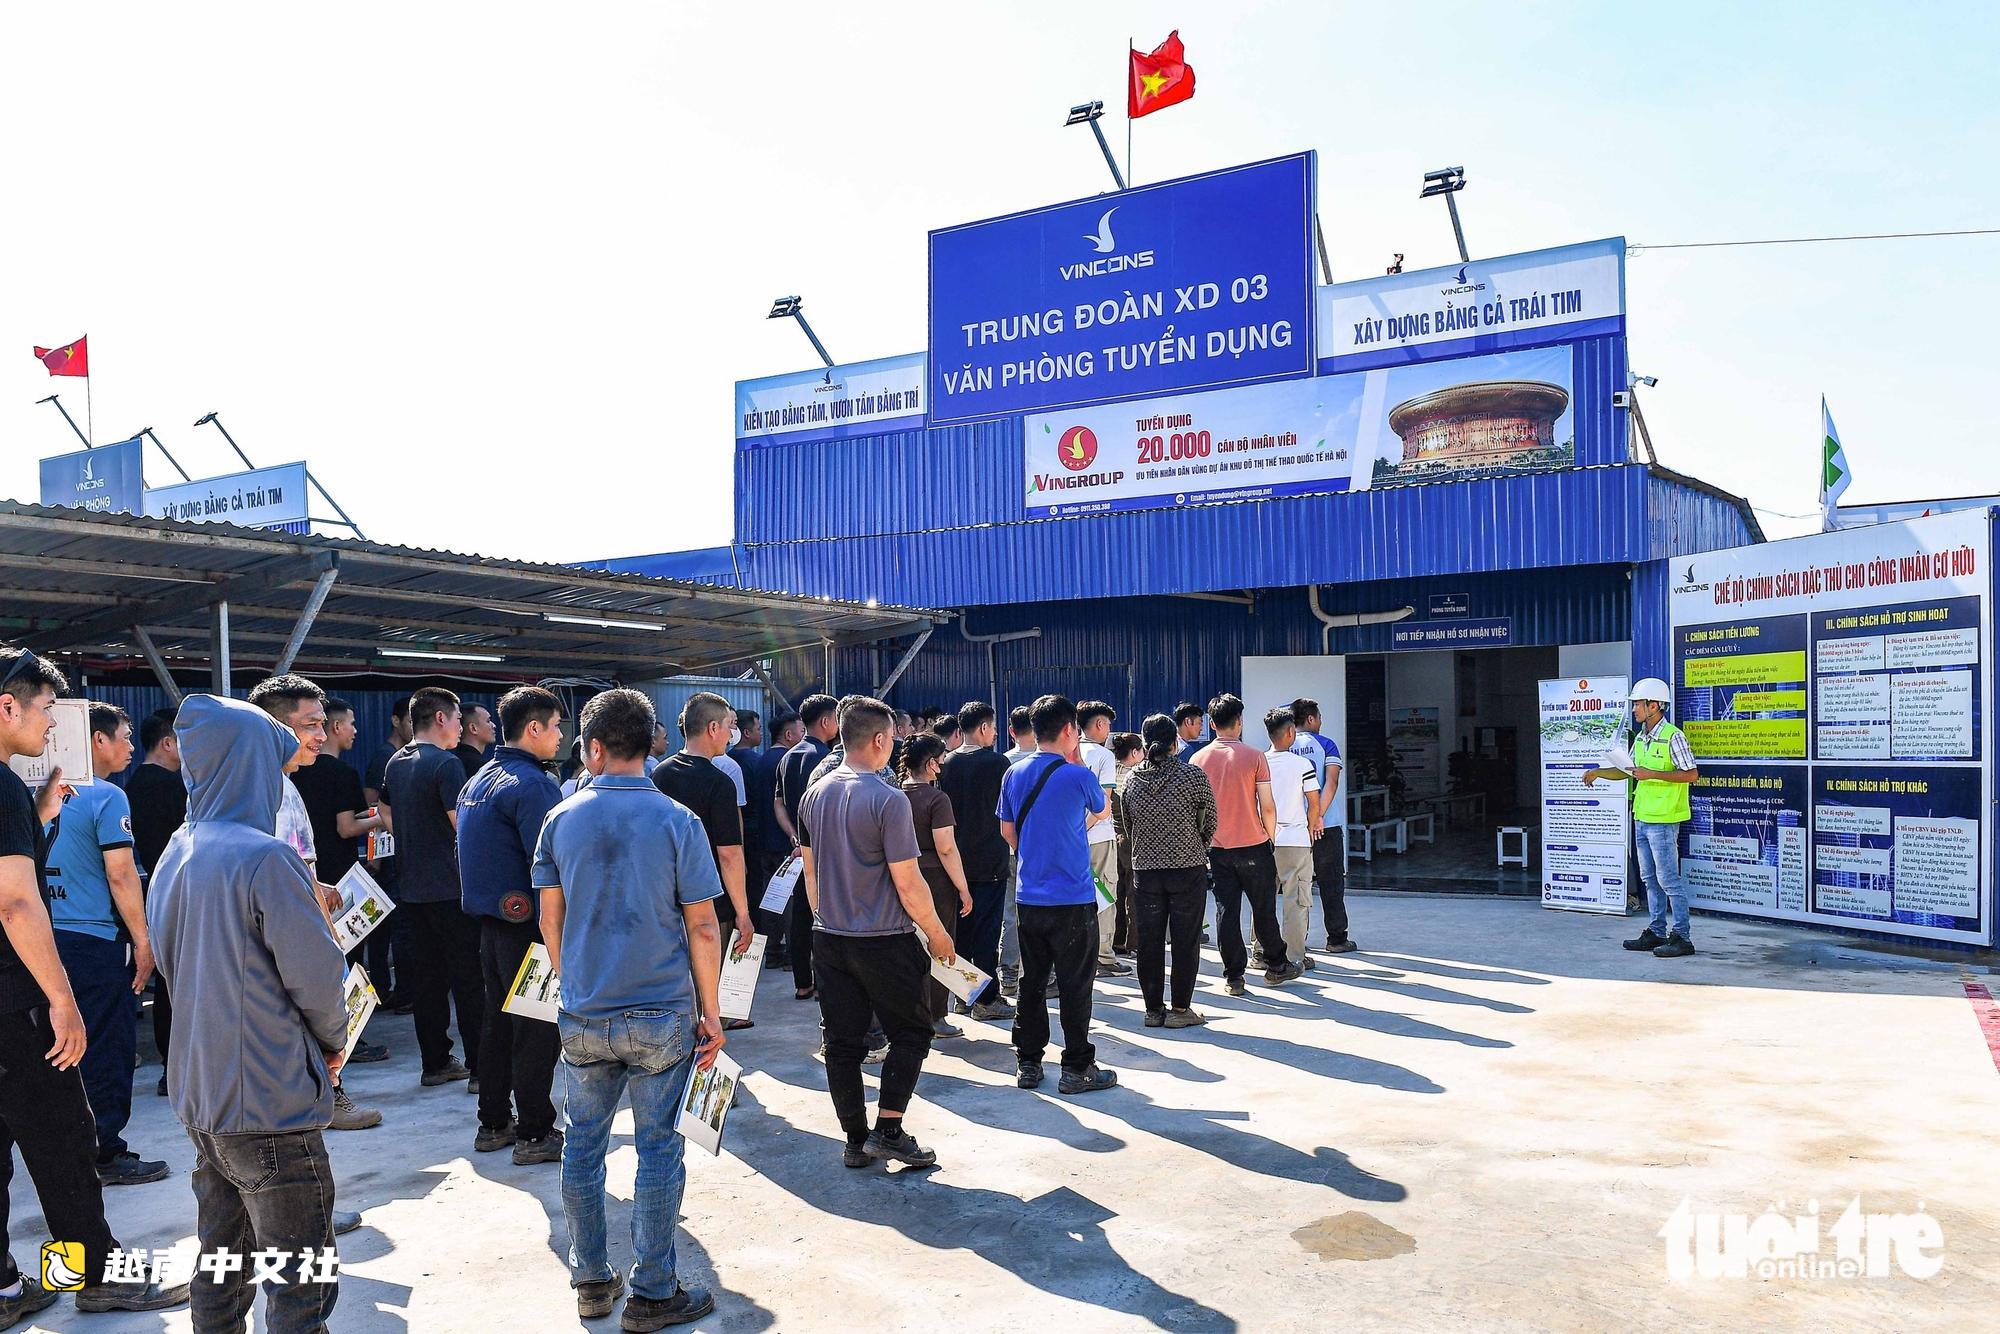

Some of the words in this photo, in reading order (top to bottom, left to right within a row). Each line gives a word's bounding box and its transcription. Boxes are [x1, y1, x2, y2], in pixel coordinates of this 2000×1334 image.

[1060, 250, 1154, 280] VINCONS
[1441, 283, 1485, 296] VINCONS
[962, 310, 1063, 347] TRUNG
[1075, 290, 1162, 329] ĐOÀN
[1174, 282, 1219, 312] XD
[1231, 274, 1268, 303] 03
[1354, 318, 1381, 344] XÂY
[1388, 315, 1430, 343] DỰNG
[1436, 301, 1478, 333] BẰNG
[1484, 295, 1504, 324] CẢ
[1510, 291, 1545, 322] TRÁI
[1551, 290, 1582, 315] TIM
[943, 361, 992, 395] VĂN
[1002, 351, 1094, 388] PHÒNG
[1103, 325, 1196, 372] TUYỂN
[1207, 321, 1292, 359] DỤNG
[814, 384, 842, 392] VINCONS
[744, 408, 762, 431] KIẾN
[765, 409, 779, 432] TẠO
[782, 401, 805, 425] BẰNG
[807, 403, 828, 423] TÂM,
[855, 390, 874, 415] TẦM
[877, 388, 901, 413] BẰNG
[904, 386, 918, 408] TRÍ
[1167, 414, 1191, 430] DỤNG
[1138, 431, 1211, 464] 20.000
[1218, 439, 1234, 453] CÁN
[1238, 437, 1248, 453] BỘ
[1251, 434, 1274, 449] NHÂN
[1278, 432, 1296, 446] VIÊN
[1146, 469, 1158, 479] TIÊN
[1160, 467, 1176, 478] NHÂN
[1220, 462, 1228, 471] ÁN
[1230, 461, 1242, 470] KHU
[1279, 456, 1295, 466] THAO
[1325, 450, 1333, 461] HÀ
[1336, 449, 1347, 461] NỘI
[1034, 471, 1124, 492] VINGROUP
[86, 495, 110, 510] PHÒNG
[205, 490, 228, 514] BẰNG
[232, 488, 243, 510] CẢ
[246, 486, 264, 507] TRÁI
[267, 488, 282, 504] TIM
[1714, 574, 1730, 605] CHẾ
[1733, 575, 1744, 607] ĐỘ
[1746, 572, 1773, 601] CHÍNH
[1776, 569, 1799, 598] SÁCH
[1802, 565, 1821, 599] ĐẶC
[1824, 562, 1842, 592] THÙ
[1845, 563, 1864, 589] CHO
[1868, 556, 1896, 586] CÔNG
[1900, 551, 1930, 582] NHÂN
[1934, 549, 1948, 578] CƠ
[1952, 545, 1974, 576] HỮU
[1674, 584, 1709, 594] VINCONS
[1826, 619, 1834, 630] III.
[1836, 616, 1857, 628] CHÍNH
[1860, 613, 1878, 627] SÁCH
[1881, 610, 1890, 624] HỖ
[1892, 611, 1906, 625] TRỢ
[1908, 610, 1926, 622] SINH
[1928, 608, 1948, 623] HOẠT
[1396, 632, 1408, 641] NƠI
[1410, 629, 1424, 640] TIẾP
[1426, 629, 1445, 641] NHẬN
[1458, 629, 1468, 638] SƠ
[1470, 627, 1489, 639] NHẬN
[1491, 626, 1507, 638] VIỆC
[1690, 629, 1708, 641] CHÍNH
[1709, 628, 1724, 640] SÁCH
[1570, 699, 1601, 711] 20.000
[1712, 776, 1727, 787] SÁCH
[1728, 775, 1740, 788] BẢO
[1760, 776, 1772, 788] BẢO
[1774, 777, 1782, 791] HỘ
[1836, 779, 1857, 791] CHÍNH
[1859, 779, 1877, 792] SÁCH
[1880, 778, 1889, 792] HỖ
[1891, 781, 1905, 794] TRỢ
[1907, 780, 1927, 793] KHÁC
